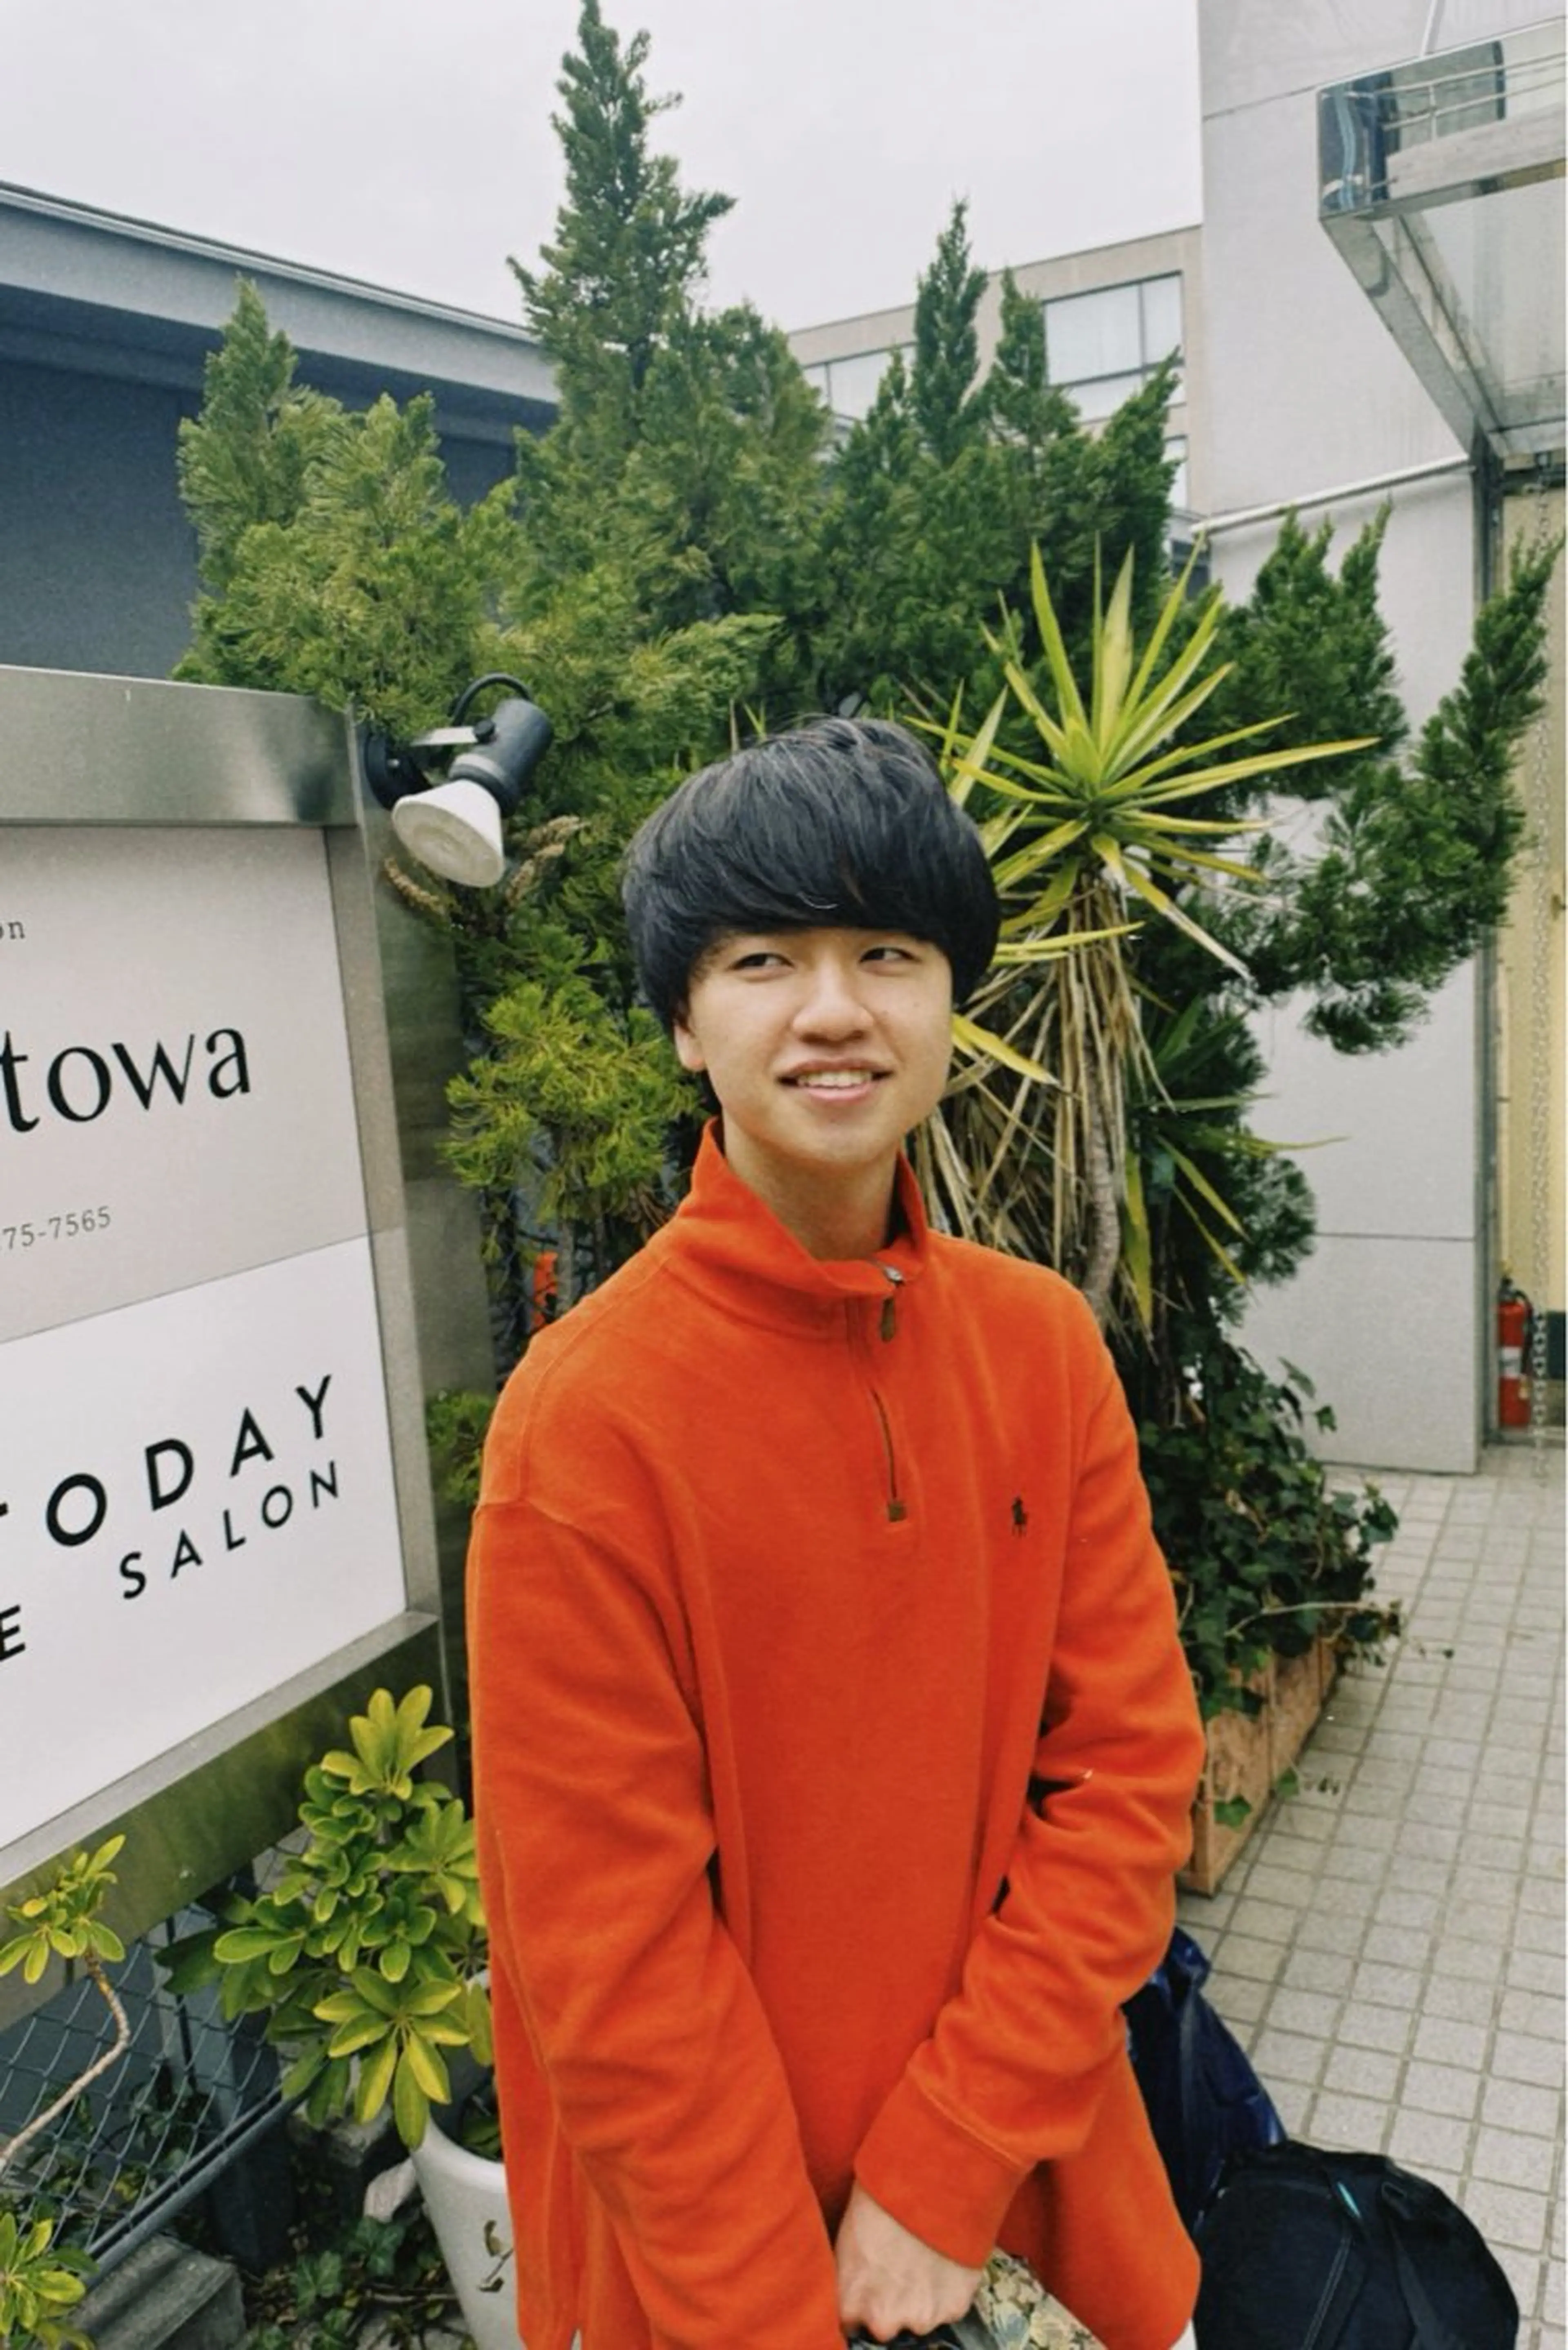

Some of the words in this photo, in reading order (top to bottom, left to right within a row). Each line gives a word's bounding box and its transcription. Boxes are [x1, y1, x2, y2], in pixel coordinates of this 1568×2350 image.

[0, 1029, 250, 1132] towa
[0, 1375, 331, 1546] ODAY
[120, 1461, 338, 1599] SALON
